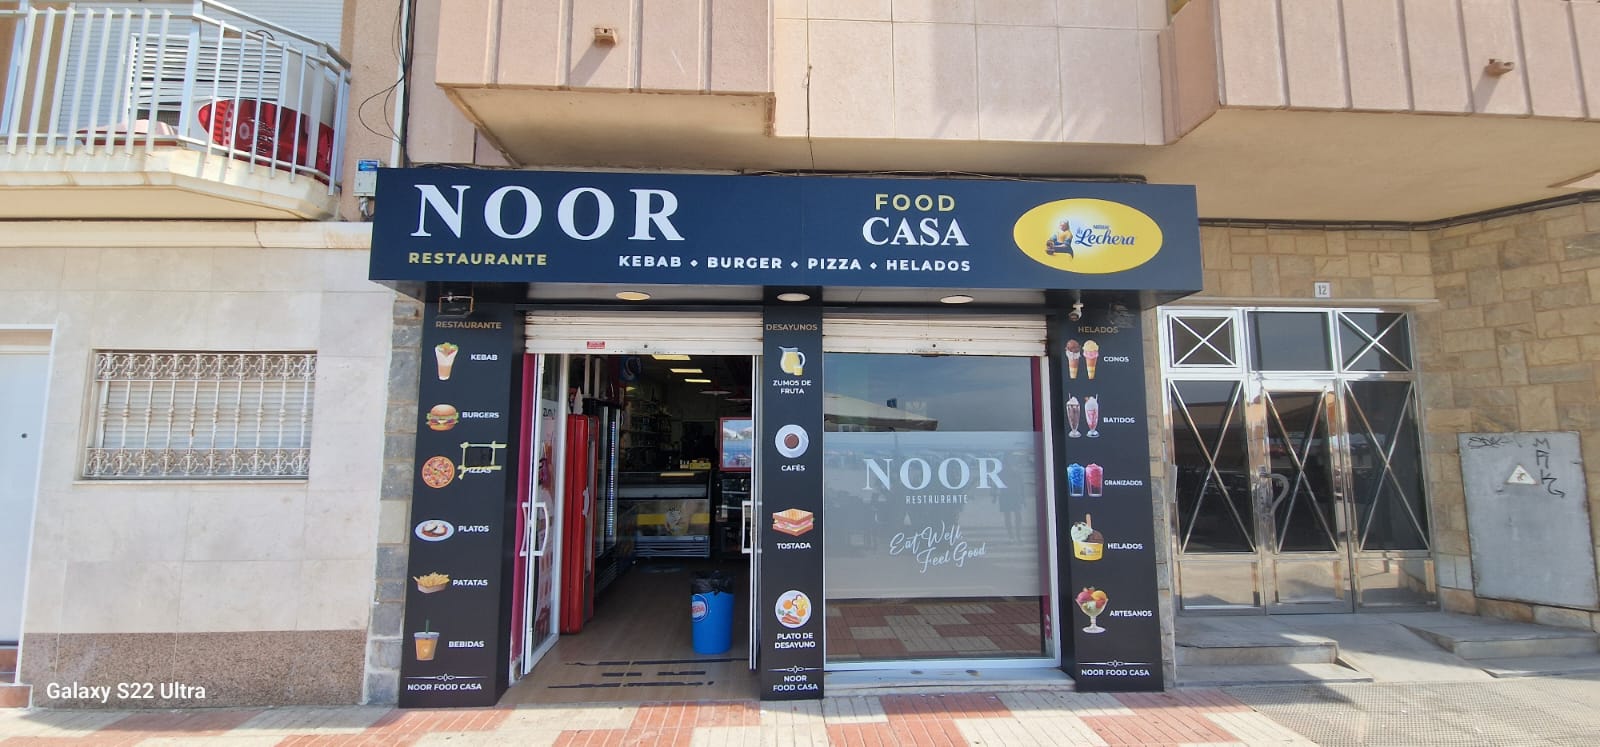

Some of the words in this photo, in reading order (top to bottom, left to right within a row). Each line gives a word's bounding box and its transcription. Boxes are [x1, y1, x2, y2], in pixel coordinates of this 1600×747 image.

[875, 193, 956, 212] FOOD
[410, 184, 685, 241] NOOR
[862, 216, 970, 247] CASA
[1075, 228, 1135, 247] Lechera
[408, 252, 547, 266] RESTAURANTE
[618, 255, 682, 268] KEBAB
[707, 256, 783, 269] BURGER
[808, 258, 862, 271] PIZZA
[886, 259, 971, 272] HELADOS
[1318, 284, 1328, 296] 12
[435, 320, 502, 330] RESTAURANTE
[766, 323, 818, 332] DESAYUNOS
[1078, 325, 1119, 335] HELADOS
[470, 353, 498, 362] KEBAB
[1103, 355, 1130, 364] CONOS
[772, 379, 799, 387] ZUMOS
[801, 379, 812, 387] DE
[780, 387, 805, 395] FRUTA
[462, 411, 500, 420] BURGERS
[1103, 416, 1136, 425] BATIDOS
[781, 463, 806, 473] CAFÉS
[863, 457, 1008, 490] NOOR
[1104, 478, 1143, 487] GRANIZADOS
[905, 494, 968, 504] RESTAURANTE
[458, 525, 490, 534] PLATOS
[776, 541, 812, 550] TOSTADA
[889, 532, 921, 555] Eat
[1107, 542, 1143, 551] HELADOS
[916, 547, 951, 573] Feel
[953, 541, 986, 567] Good
[452, 578, 488, 587] PATATAS
[1109, 609, 1153, 618] ARTESANOS
[776, 632, 802, 641] PLATO
[802, 632, 814, 640] DE
[448, 640, 485, 649] BEBIDAS
[774, 641, 816, 650] DESAYUNO
[1081, 668, 1105, 677] NOOR
[1105, 668, 1128, 677] FOOD
[1129, 668, 1150, 677] CASA
[783, 674, 808, 683] NOOR
[407, 682, 433, 692] NOOR
[433, 682, 459, 691] FOOD
[459, 682, 482, 691] CASA
[772, 684, 797, 693] FOOD
[797, 684, 819, 692] CASA
